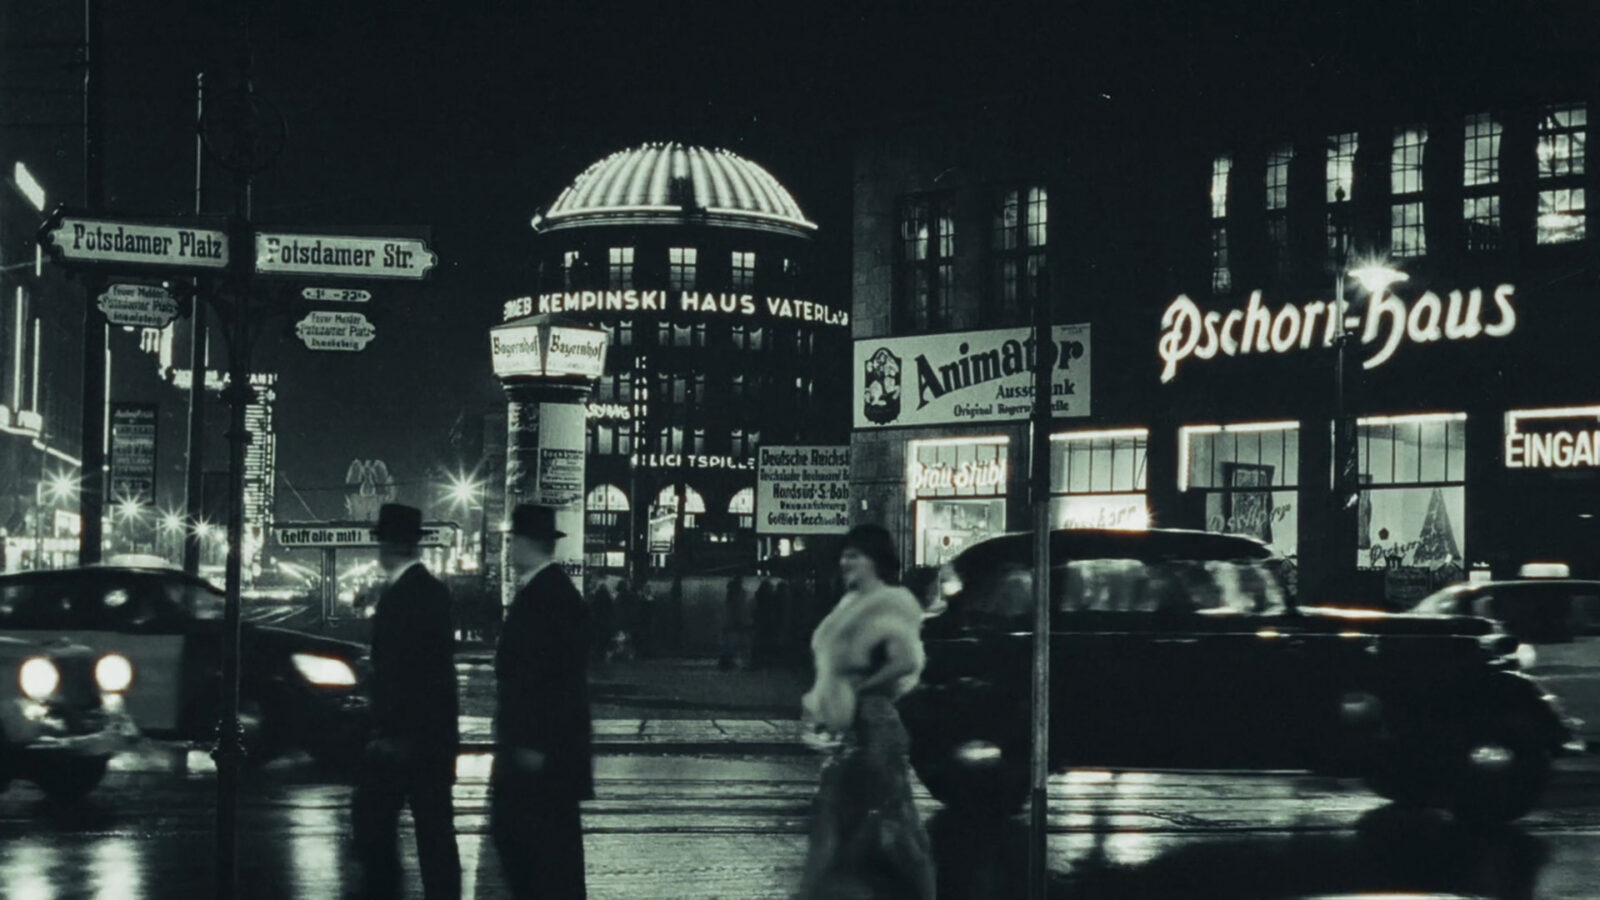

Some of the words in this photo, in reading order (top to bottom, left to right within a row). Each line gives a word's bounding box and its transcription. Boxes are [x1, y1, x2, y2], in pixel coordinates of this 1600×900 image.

[73, 223, 172, 256] Potsdamer
[178, 231, 222, 259] Platz
[267, 237, 375, 267] Potsdamer
[383, 244, 414, 269] Str.
[538, 290, 667, 314] KEMPINSKI
[681, 290, 756, 314] HAUS
[550, 334, 604, 361] Bayernhof
[995, 379, 1076, 399] Ausscnk
[953, 403, 993, 419] Original
[761, 449, 809, 466] Deutsche
